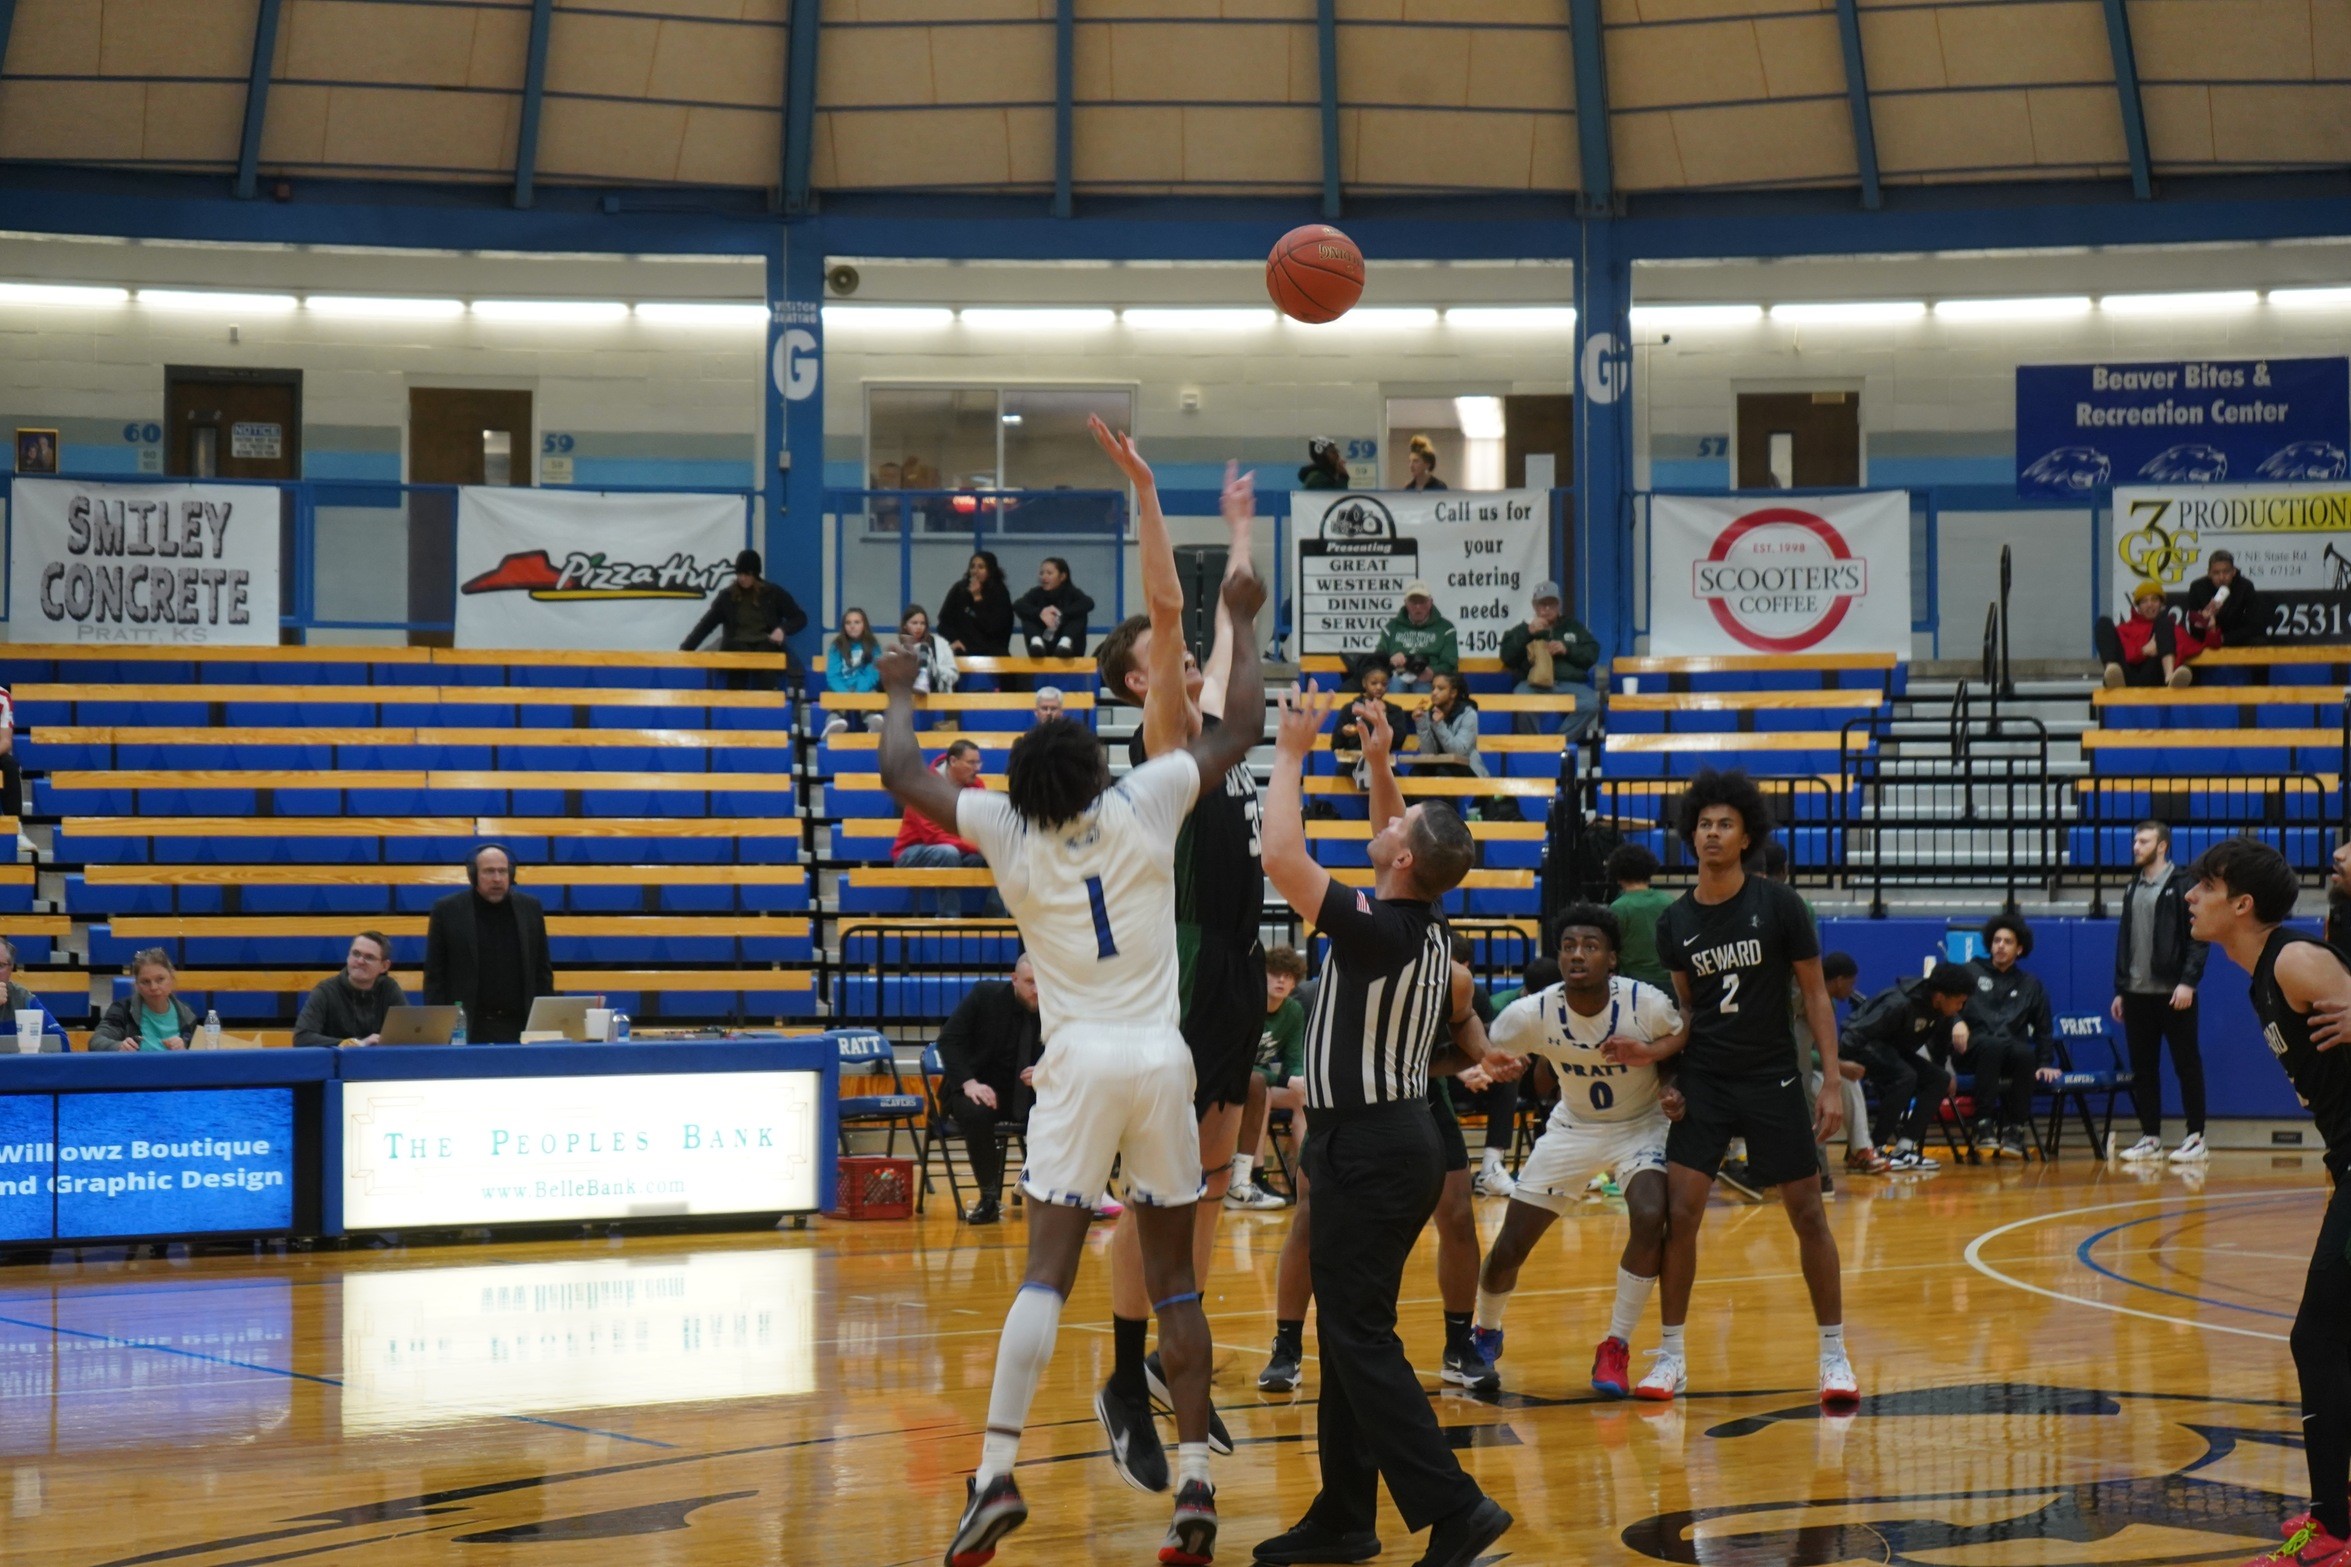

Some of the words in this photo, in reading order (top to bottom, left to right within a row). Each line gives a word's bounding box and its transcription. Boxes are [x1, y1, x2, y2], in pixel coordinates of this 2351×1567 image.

[772, 329, 818, 400] G
[1581, 332, 1628, 404] G
[2092, 366, 2177, 390] Beaver
[2185, 364, 2245, 388] Bites
[2253, 362, 2272, 387] &
[2076, 400, 2204, 427] Recreation
[2211, 399, 2288, 423] Center
[123, 423, 161, 443] 60
[544, 434, 574, 452] 59
[1346, 440, 1377, 459] 59
[1698, 437, 1728, 457] 57
[1434, 501, 1470, 521] Call
[1478, 505, 1498, 521] us
[1506, 500, 1531, 520] for
[2179, 497, 2351, 529] PRODUCTION
[67, 496, 232, 558] SMILEY
[1326, 541, 1392, 554] Presenting
[1464, 539, 1503, 558] your
[1753, 544, 1775, 553] EST.
[1780, 543, 1805, 553] 1998
[2264, 550, 2289, 561] State
[555, 551, 654, 590] Pizza
[1330, 559, 1389, 572] GREAT
[2249, 566, 2264, 576] KS
[1317, 579, 1403, 591] WESTERN
[1448, 567, 1520, 590] catering
[1700, 564, 1859, 592] SCOOTER'S
[40, 562, 249, 625] CONCRETE
[1328, 598, 1392, 610] DINING
[1460, 598, 1509, 619] needs
[1739, 596, 1818, 614] COFFEE
[1321, 617, 1392, 630] SERVIC
[173, 628, 208, 643] KS
[1085, 876, 1119, 961] 1
[1691, 938, 1762, 977] SEWARD
[1720, 973, 1740, 1014] 2
[2060, 1016, 2103, 1036] PRATT
[838, 1036, 881, 1055] RATT
[1560, 1062, 1629, 1077] PRATT
[1589, 1081, 1613, 1110] 0
[0, 1142, 123, 1164] Willowz
[131, 1138, 270, 1161] Boutique
[384, 1132, 453, 1160] THE
[489, 1126, 650, 1156] PEOPLES
[682, 1122, 774, 1150] BANK
[47, 1171, 173, 1197] Graphic
[181, 1168, 283, 1191] Design
[481, 1178, 686, 1199] www.BelleBank.com
